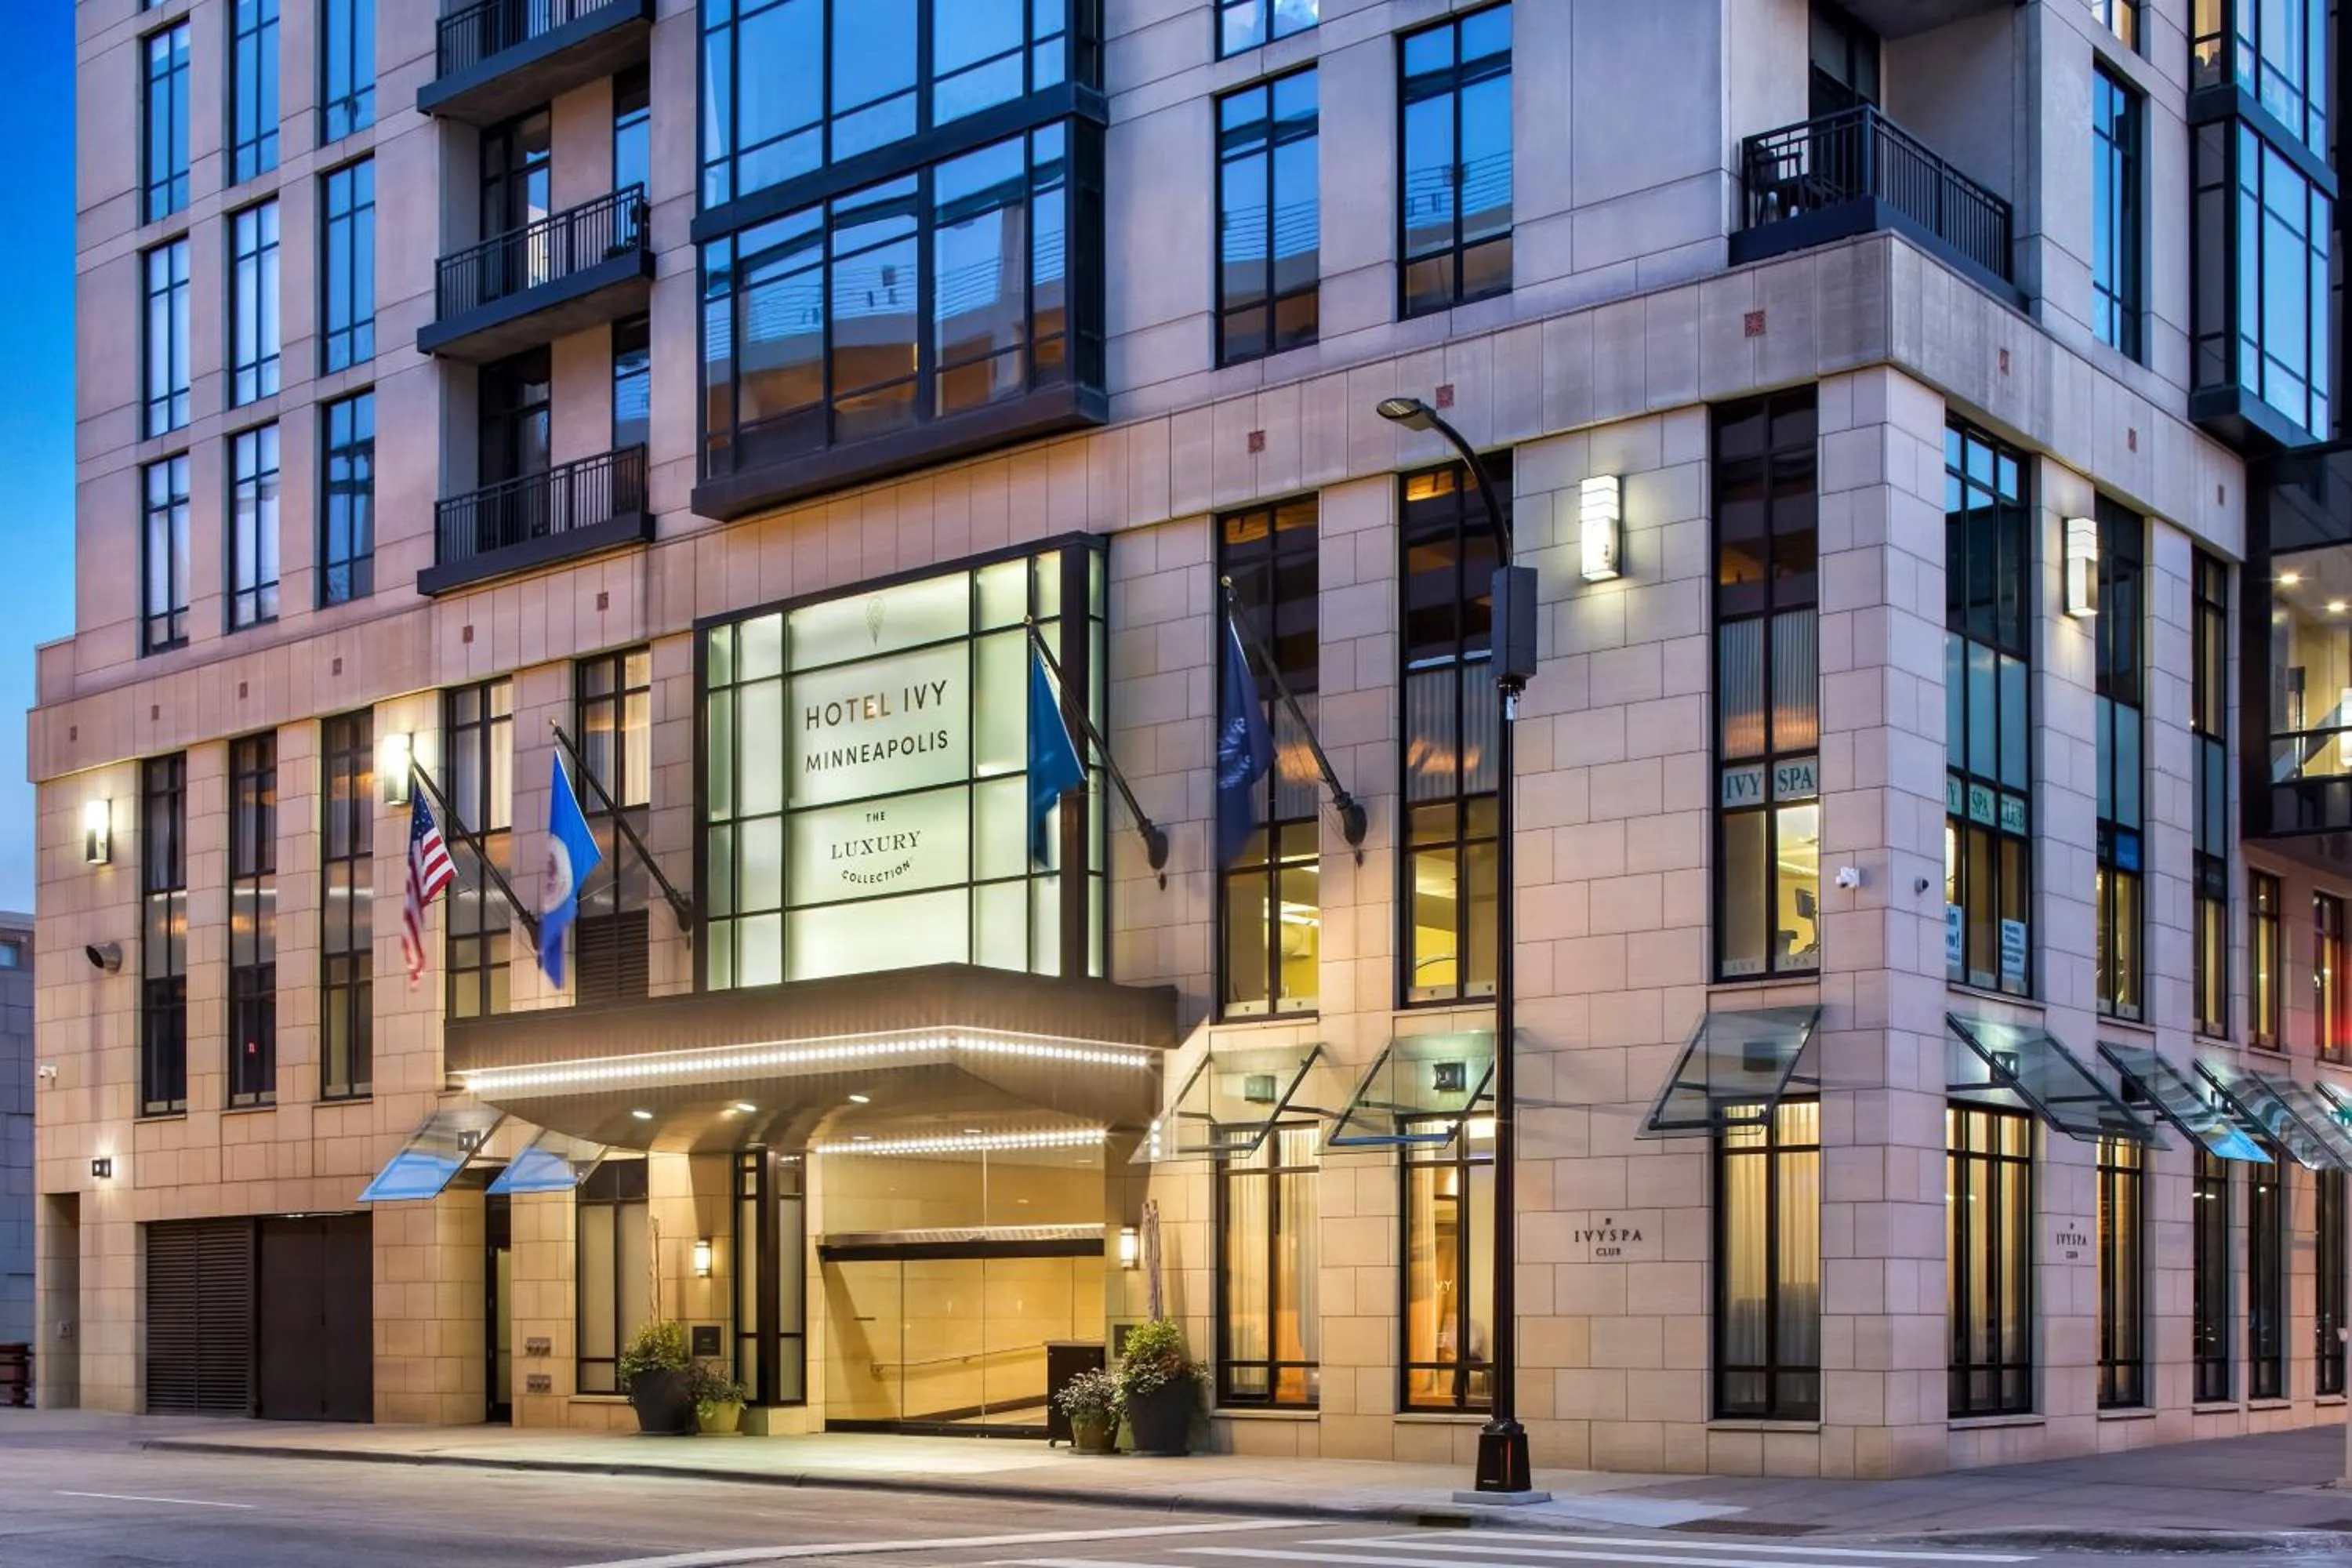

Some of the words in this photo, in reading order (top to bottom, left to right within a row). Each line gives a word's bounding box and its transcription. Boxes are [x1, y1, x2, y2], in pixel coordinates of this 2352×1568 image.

[806, 692, 891, 731] HOTEL
[904, 680, 947, 713] IVY
[805, 730, 949, 773] MINNEAPOLIS
[1726, 772, 1762, 799] IVY
[1777, 765, 1814, 793] SPA
[866, 811, 886, 822] THE
[830, 829, 922, 860] LUXURY
[840, 859, 910, 884] COLLECTION
[1595, 1247, 1621, 1257] CLUB
